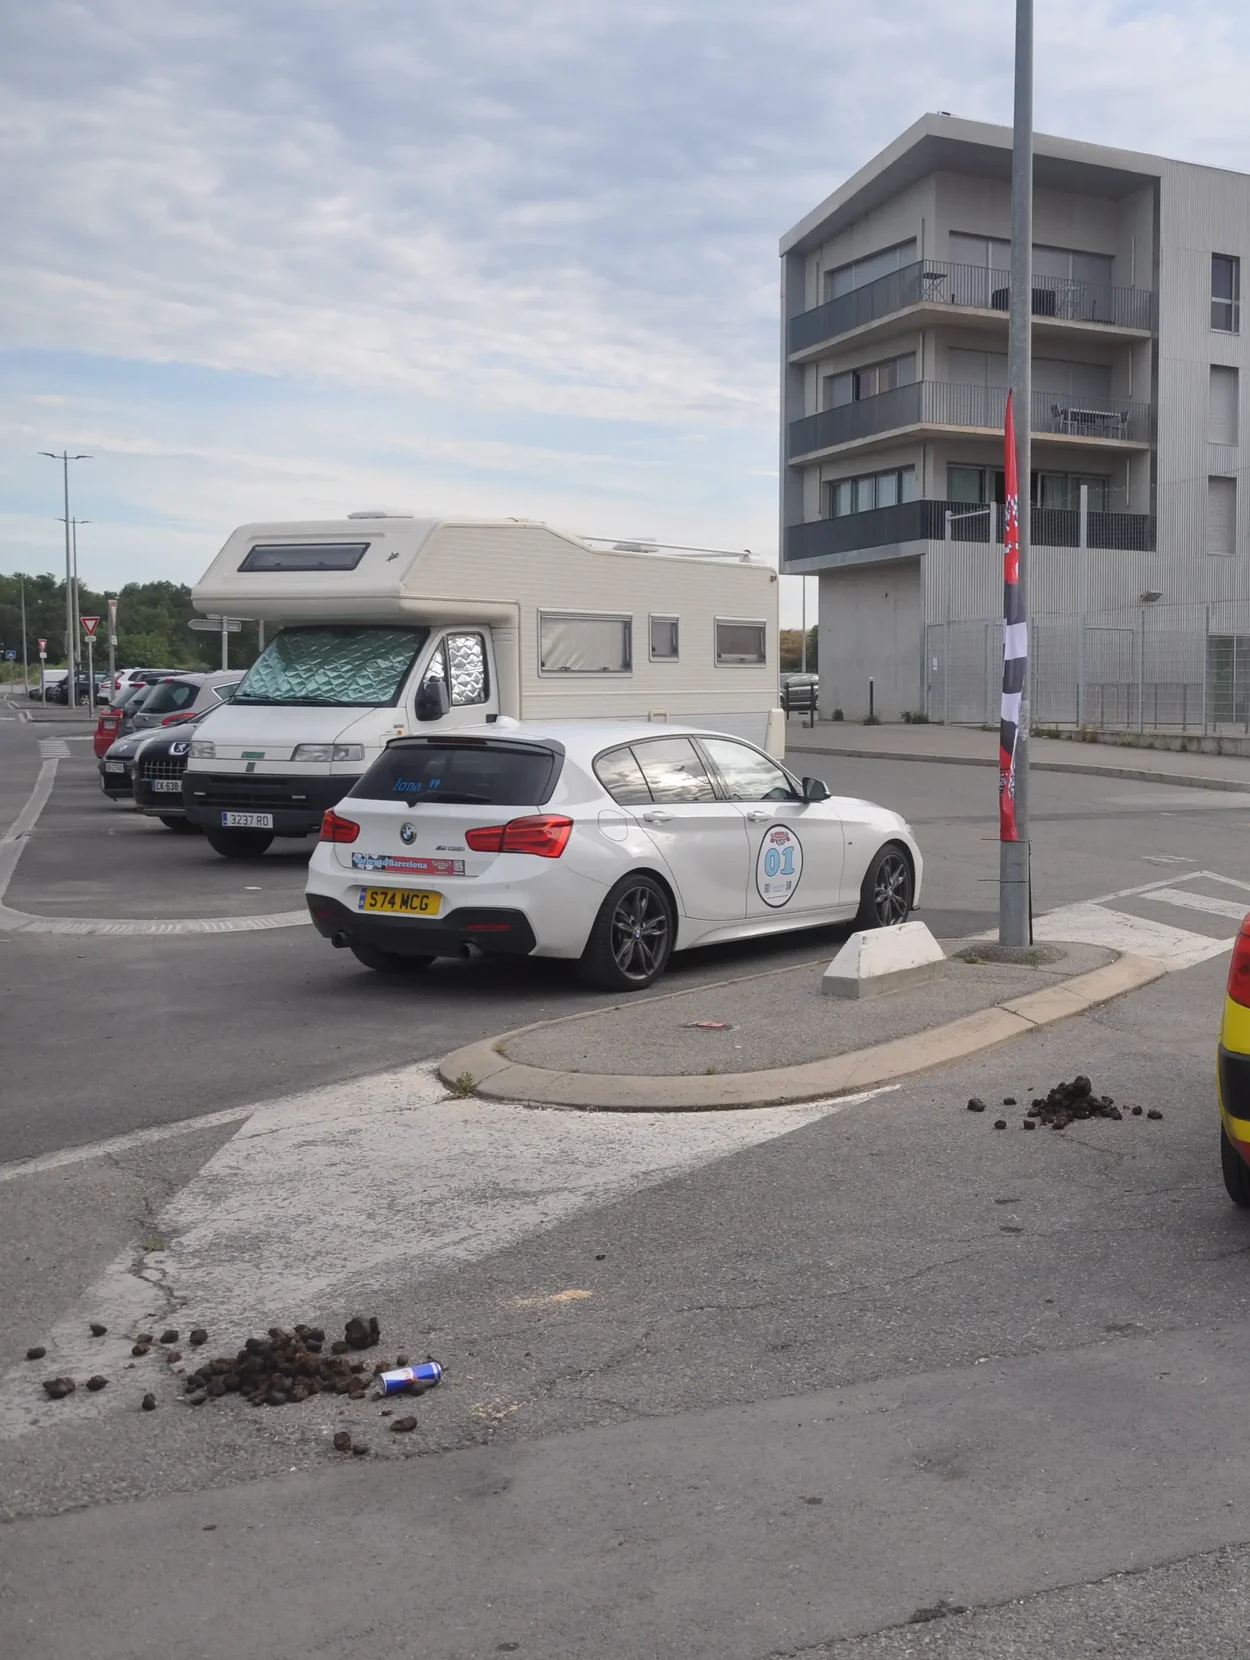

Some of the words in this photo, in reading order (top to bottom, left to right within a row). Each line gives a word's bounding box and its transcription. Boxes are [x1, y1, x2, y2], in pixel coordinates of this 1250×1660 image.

[230, 814, 253, 826] 3237
[389, 859, 427, 869] Barcelona
[764, 846, 795, 877] 01
[369, 891, 396, 908] S74
[399, 893, 430, 911] MCG
